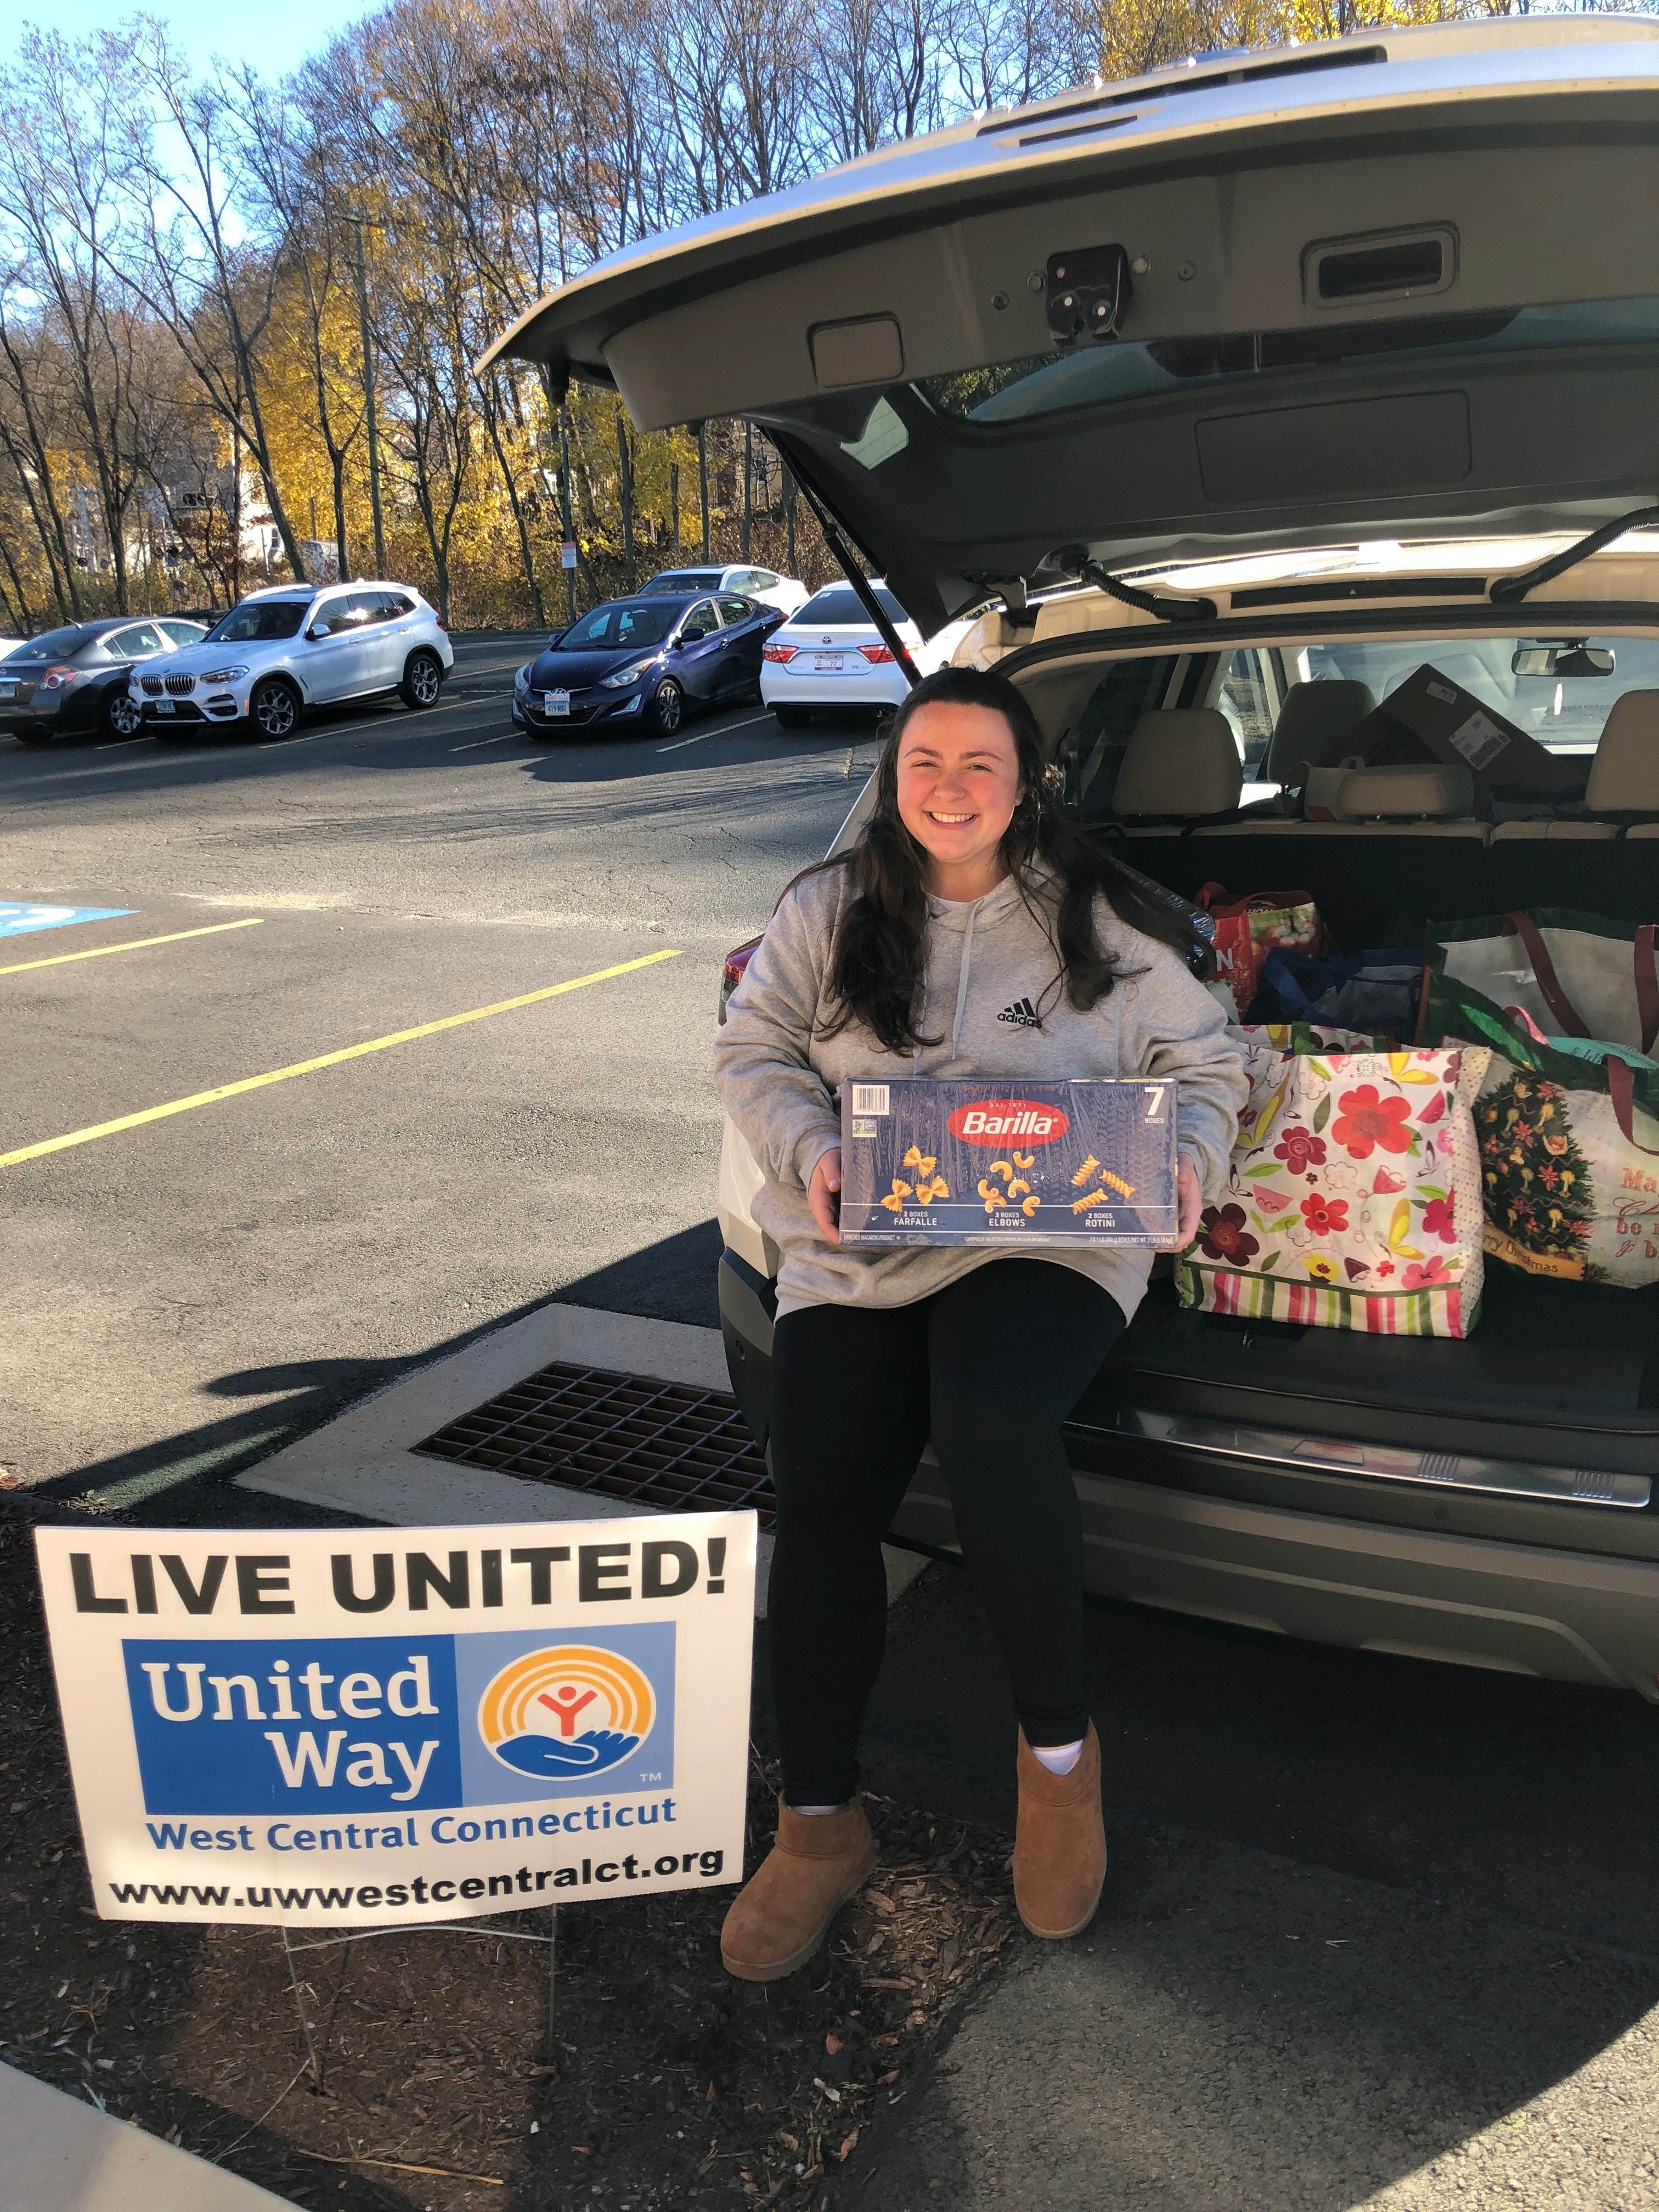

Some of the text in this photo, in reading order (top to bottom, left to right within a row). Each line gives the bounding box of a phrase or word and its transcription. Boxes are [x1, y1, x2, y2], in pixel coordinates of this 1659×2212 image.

[1144, 1087, 1164, 1115] 7
[962, 1111, 1052, 1135] Barilla
[989, 1218, 1025, 1227] ELBOWS
[1085, 1219, 1115, 1227] ROTINI
[1617, 1217, 1642, 1235] be
[70, 1537, 726, 1615] LIVE UNITED!
[141, 1655, 439, 1722] United
[264, 1730, 440, 1802] Way
[145, 1797, 677, 1852] West Central Connecticut
[109, 1850, 724, 1909] www.uwwestcentralct.org
